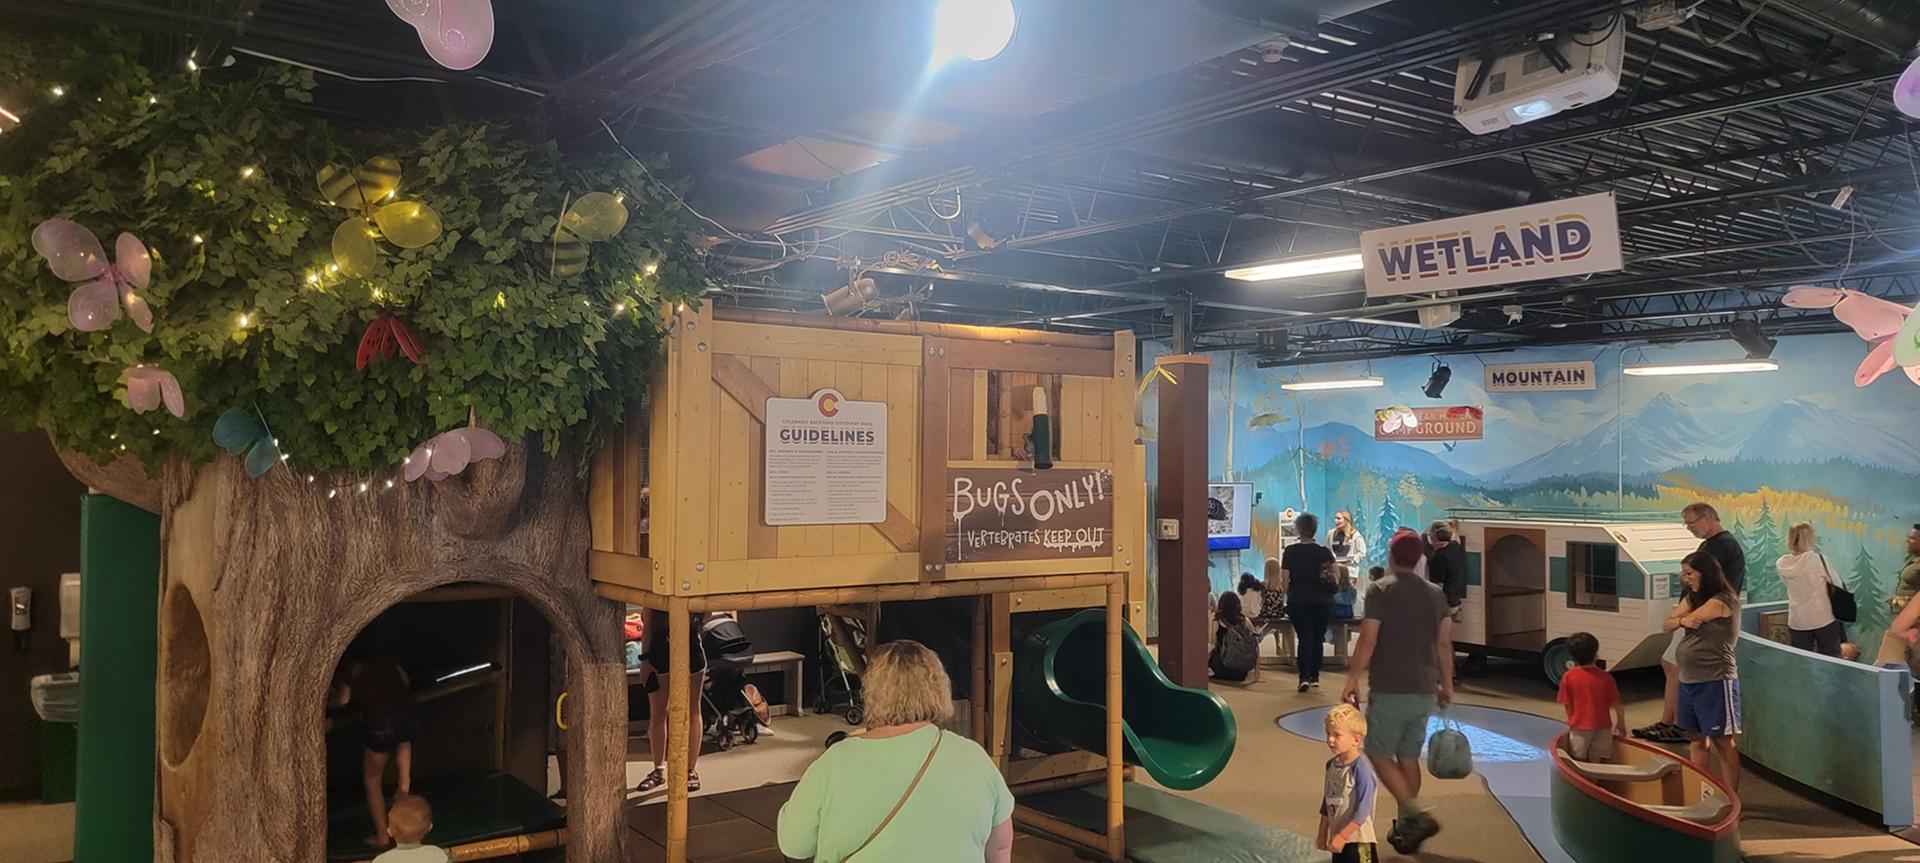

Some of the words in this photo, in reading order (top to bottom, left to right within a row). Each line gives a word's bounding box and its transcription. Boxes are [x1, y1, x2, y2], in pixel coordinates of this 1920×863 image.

[1377, 217, 1592, 279] WETLAND
[1492, 369, 1585, 385] MOUNTAIN
[780, 428, 875, 444] GUIDELINES
[953, 477, 1026, 521] BUGS
[1030, 471, 1105, 521] ONLY!
[1043, 528, 1072, 546] KEEP
[1075, 526, 1105, 546] OUT
